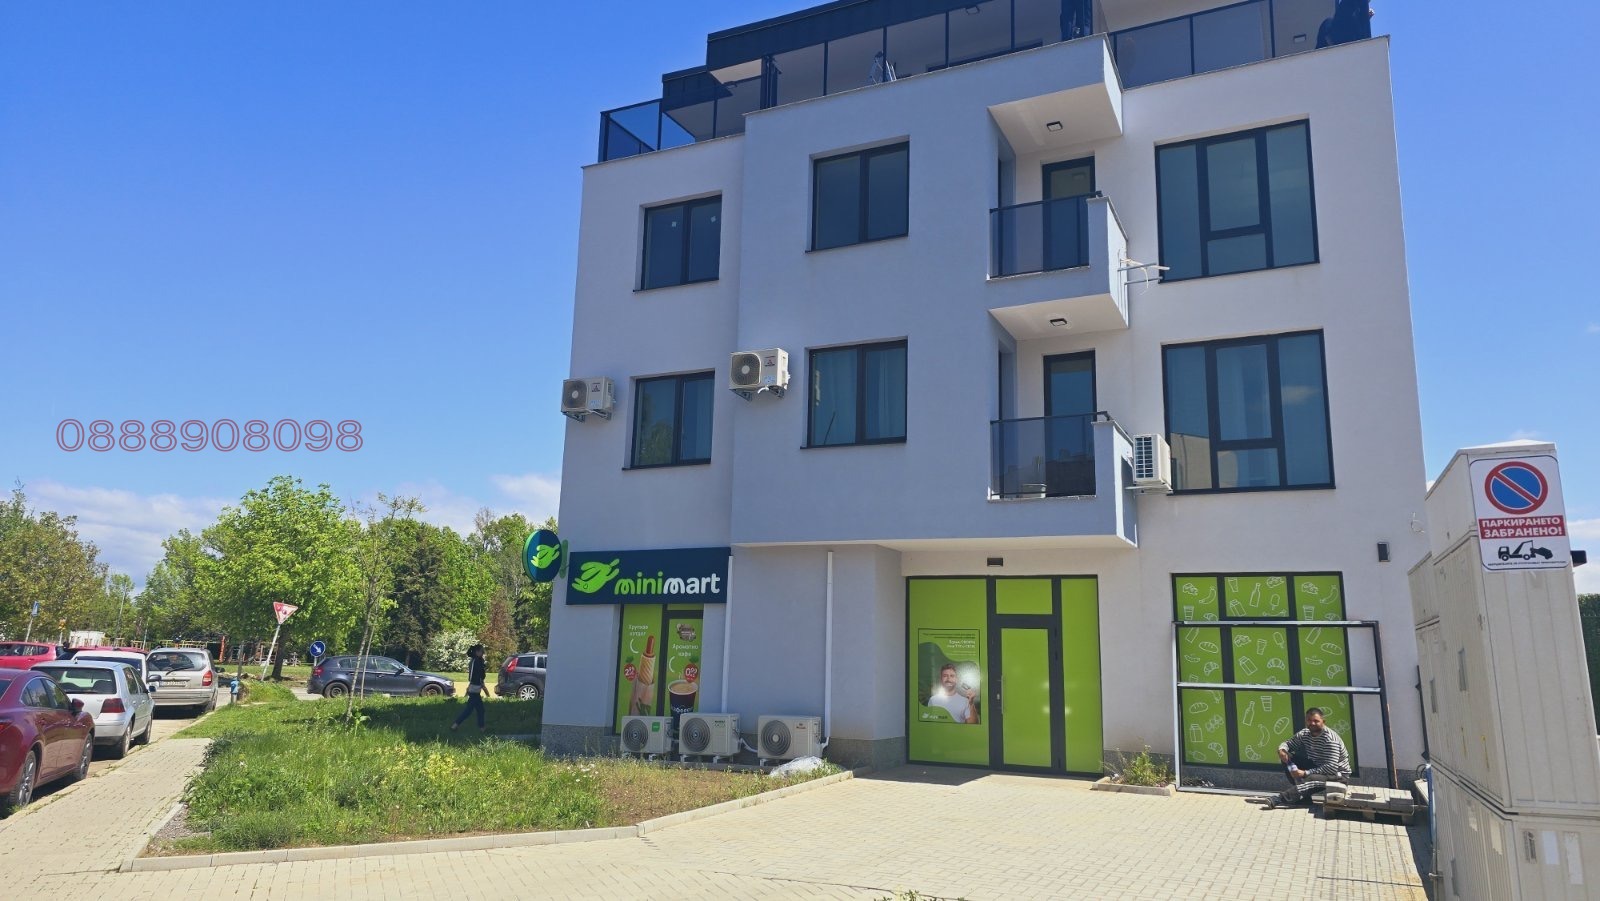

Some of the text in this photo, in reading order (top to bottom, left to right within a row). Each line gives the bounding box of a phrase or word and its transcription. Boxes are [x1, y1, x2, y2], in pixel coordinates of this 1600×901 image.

[1482, 517, 1561, 528] ПАРКИРАНЕТО
[1484, 527, 1563, 538] ЗАБРАНЕНО!
[614, 571, 721, 595] minimart
